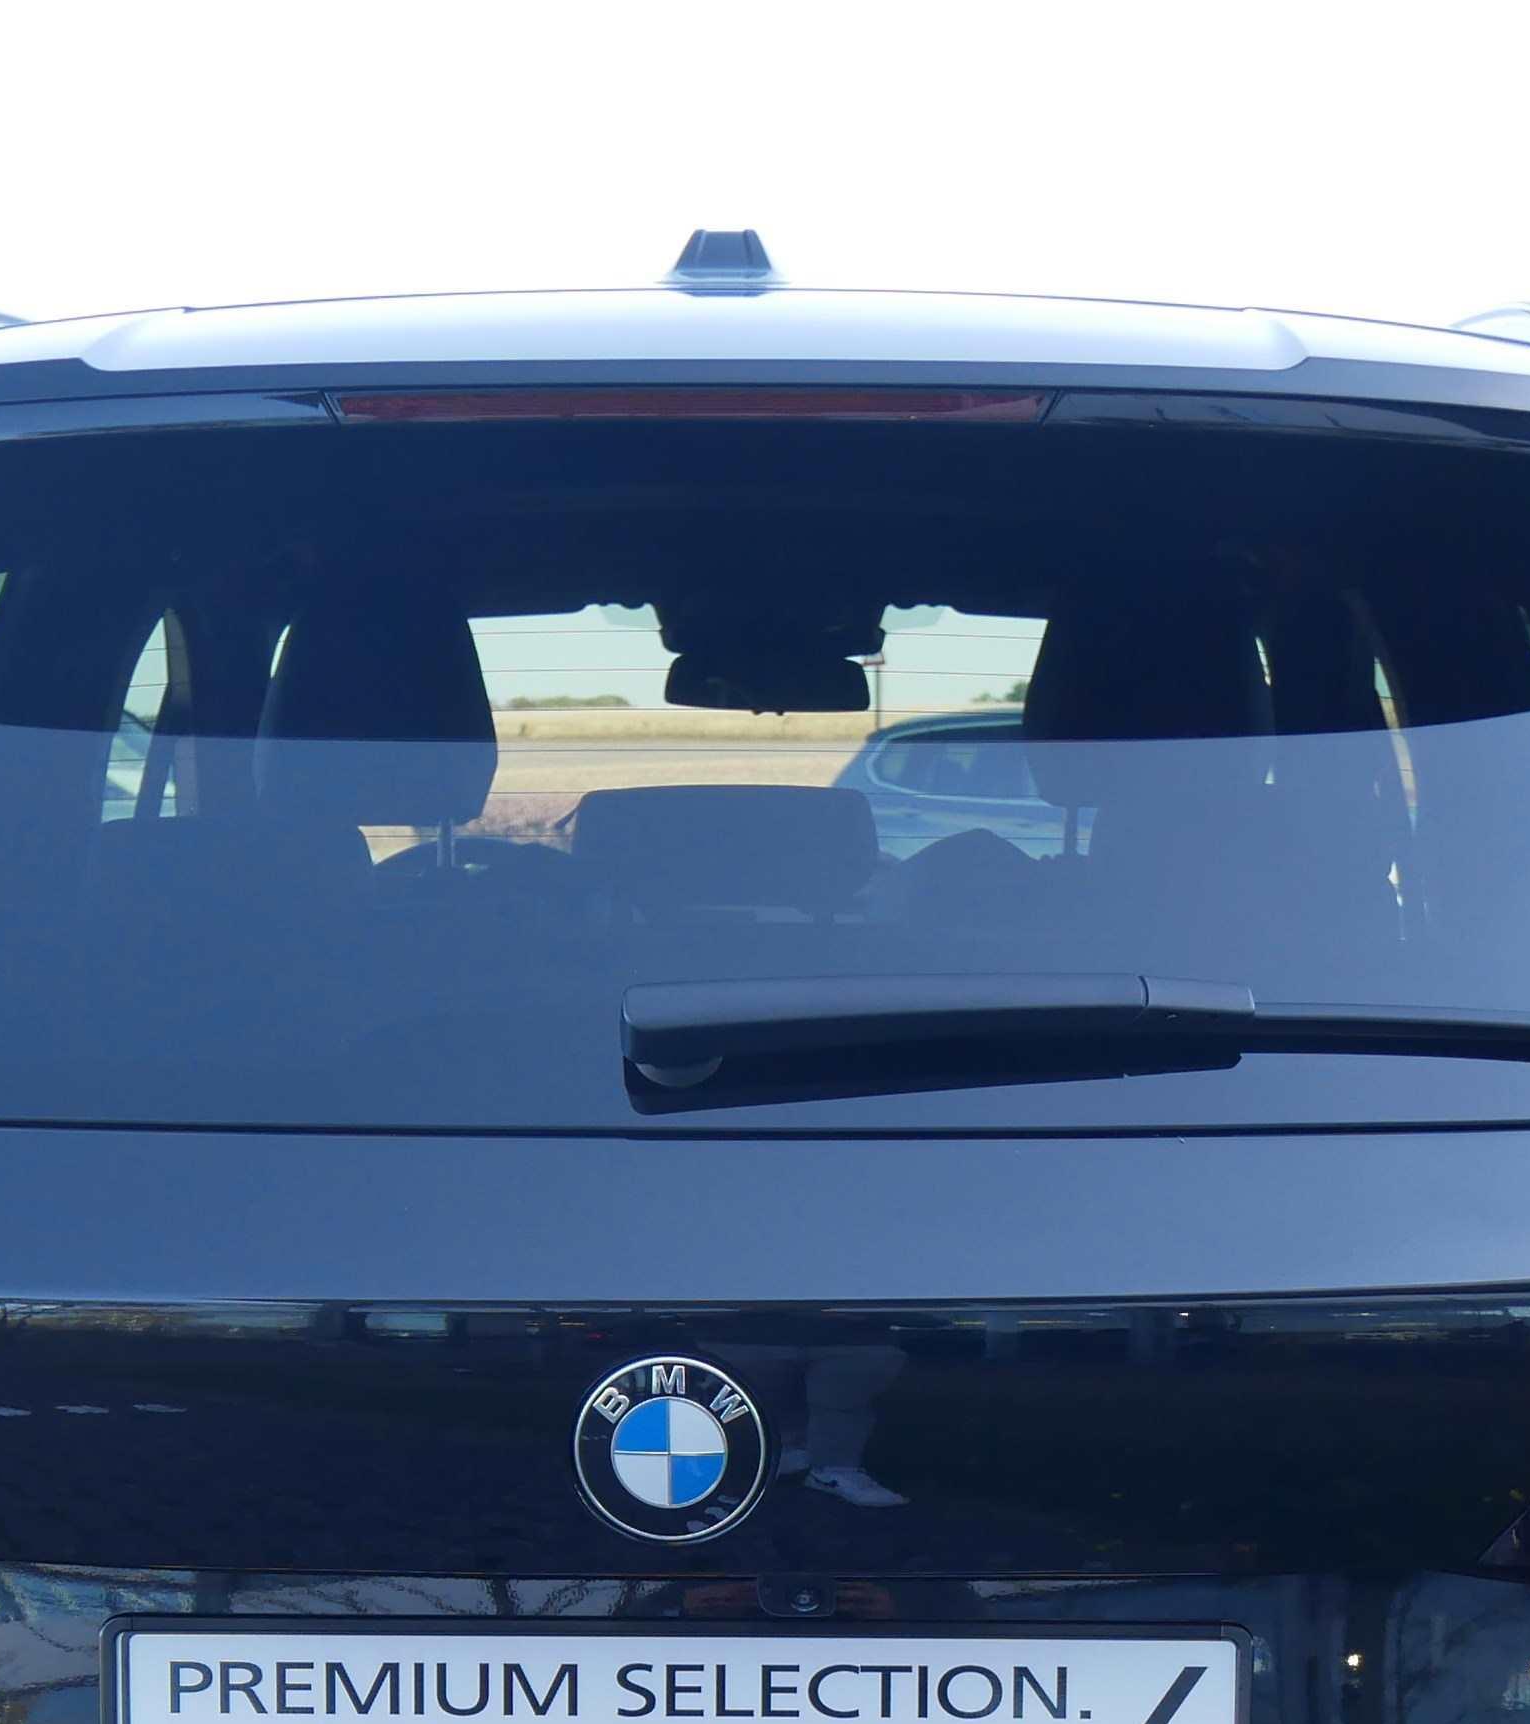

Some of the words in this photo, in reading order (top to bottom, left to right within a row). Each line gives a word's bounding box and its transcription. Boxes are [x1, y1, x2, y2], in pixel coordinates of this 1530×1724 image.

[592, 1364, 750, 1425] BMW
[169, 1660, 579, 1718] PREMIUM
[615, 1662, 1093, 1721] SELECTION.
